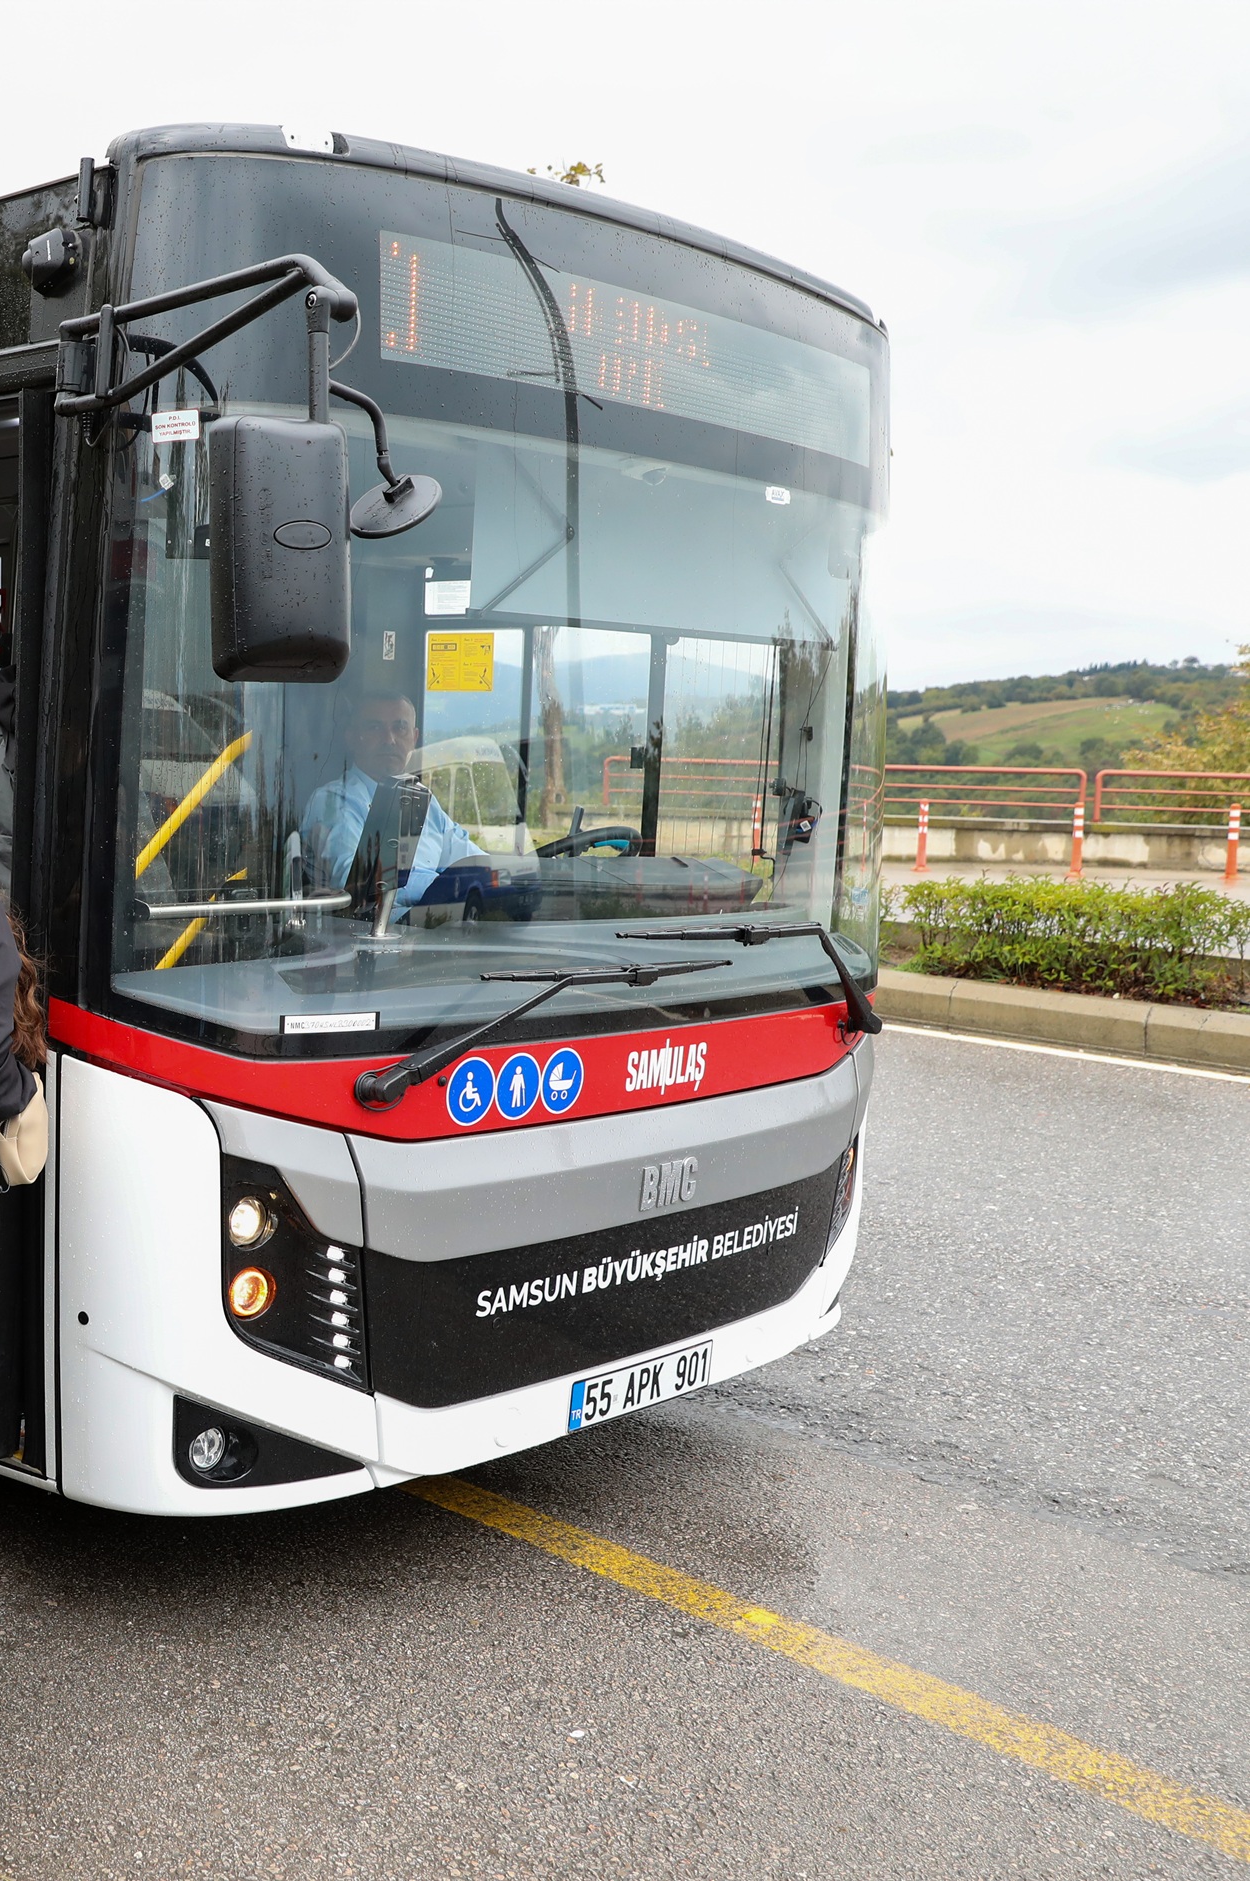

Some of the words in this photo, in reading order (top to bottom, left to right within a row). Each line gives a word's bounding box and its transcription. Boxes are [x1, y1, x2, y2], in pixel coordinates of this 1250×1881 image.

[638, 1156, 699, 1212] BMC
[475, 1270, 578, 1318] SAMSUN
[581, 1233, 709, 1293] BÜYÜKŞEHİR
[711, 1205, 800, 1260] BELEDİYESİ
[571, 1408, 582, 1421] TR
[584, 1377, 614, 1421] 55
[622, 1362, 665, 1410] APK
[675, 1347, 709, 1391] 901
